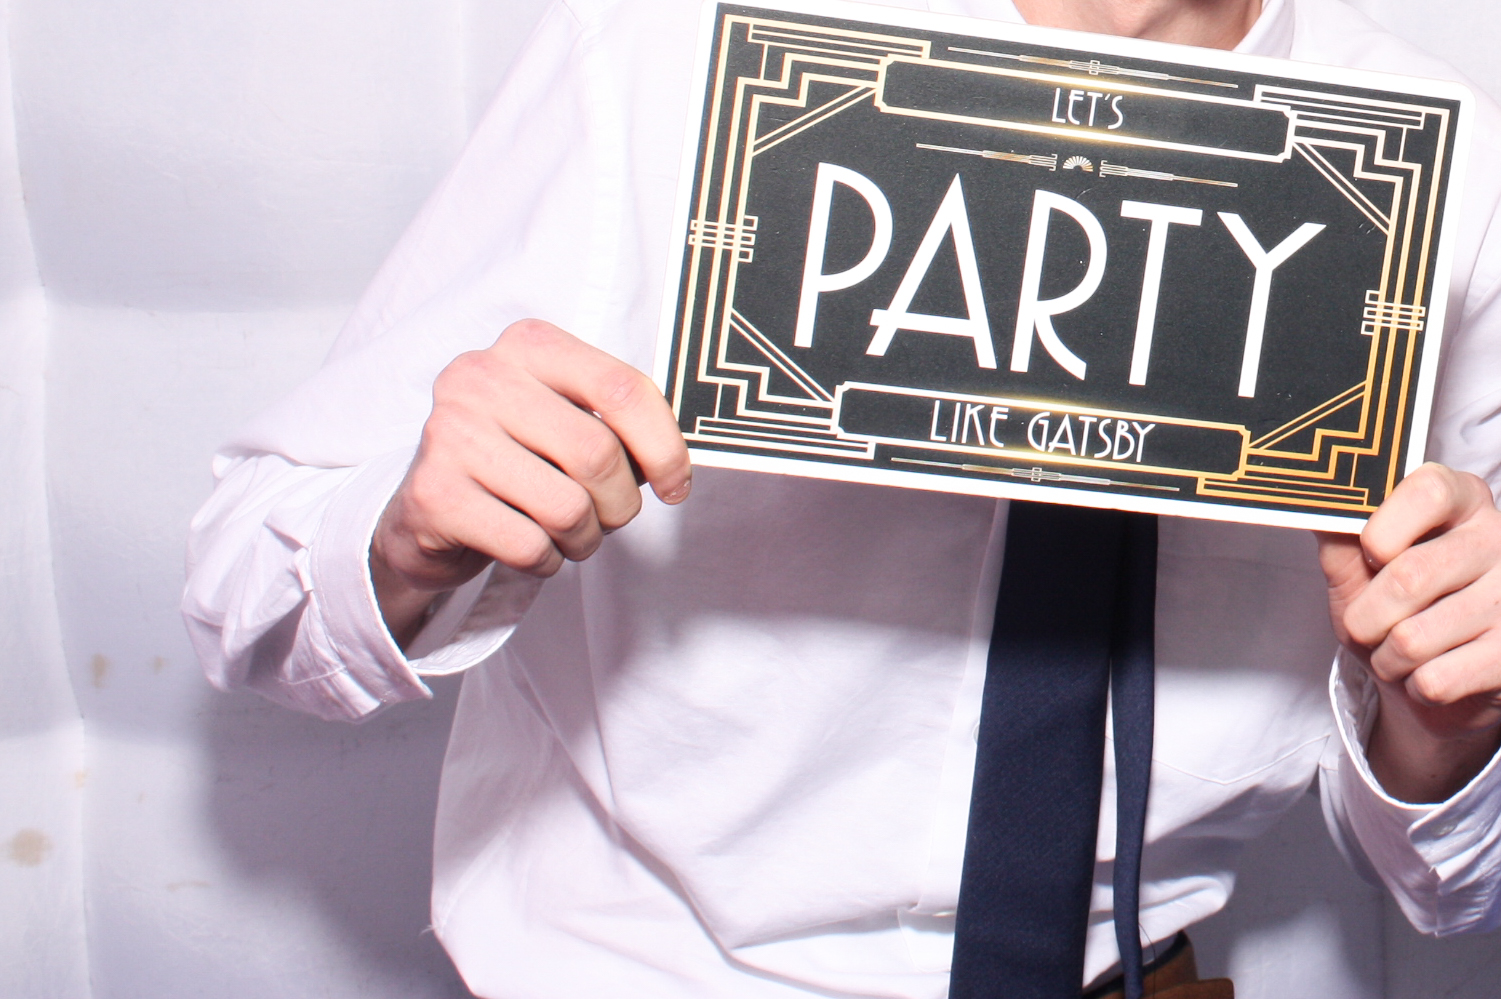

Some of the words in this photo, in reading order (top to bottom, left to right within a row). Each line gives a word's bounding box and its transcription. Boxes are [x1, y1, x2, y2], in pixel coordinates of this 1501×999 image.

[1050, 86, 1125, 130] LET'S
[793, 161, 1328, 399] PARTY
[929, 400, 1010, 449] LIKE
[1026, 411, 1156, 464] GATSBY
